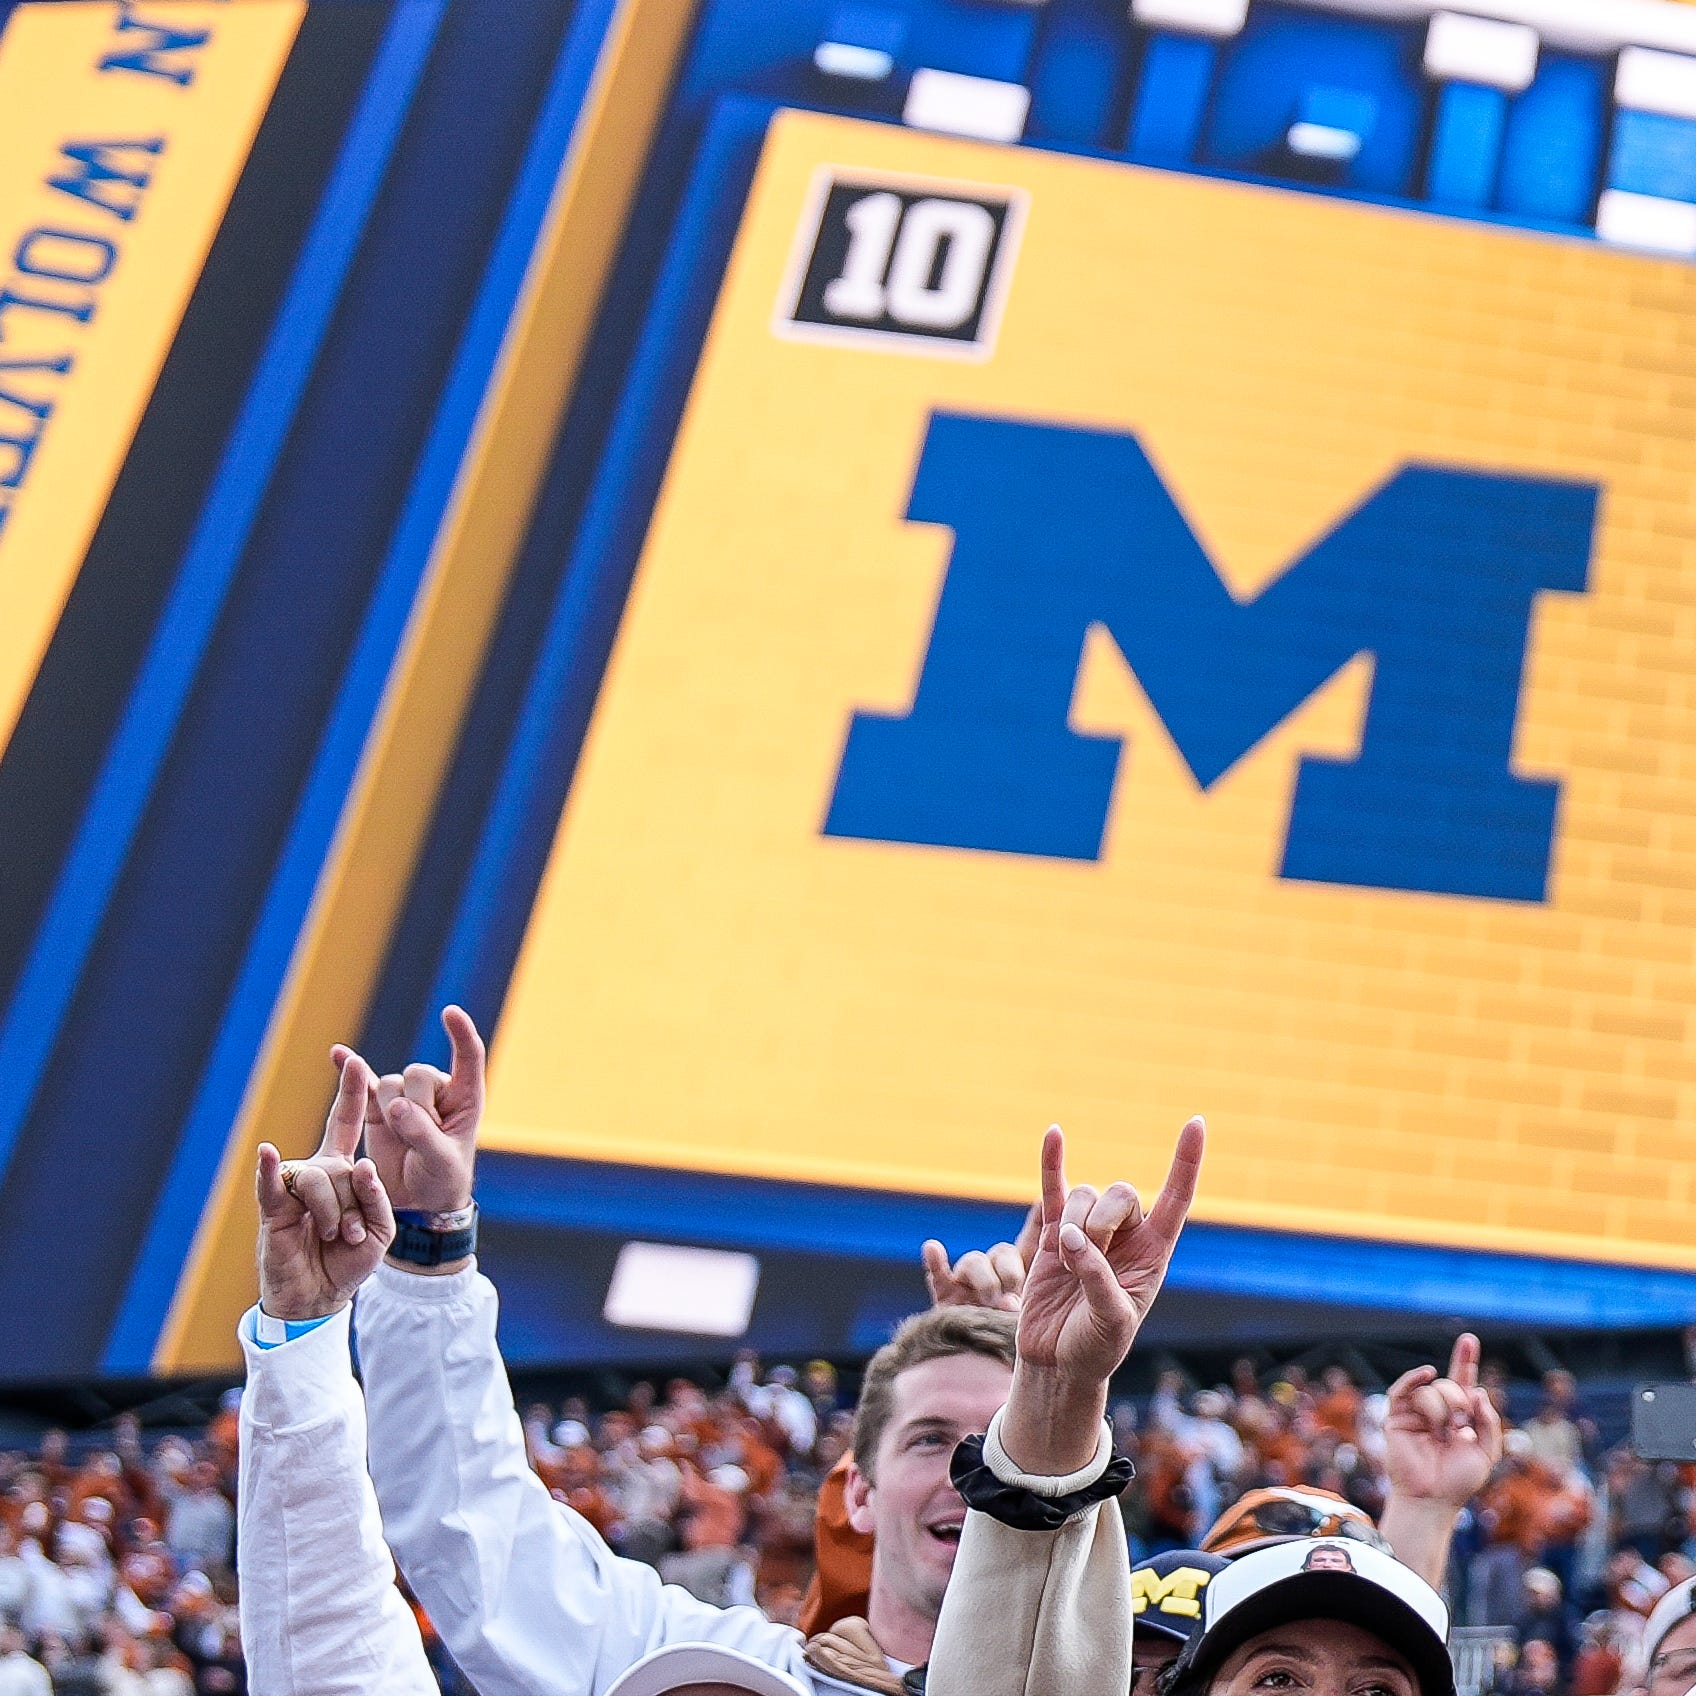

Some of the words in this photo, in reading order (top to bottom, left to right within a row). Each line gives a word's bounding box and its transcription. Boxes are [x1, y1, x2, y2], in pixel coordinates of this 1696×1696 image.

[822, 190, 996, 329] 10
[817, 407, 1604, 905] M
[1130, 1566, 1211, 1617] M
